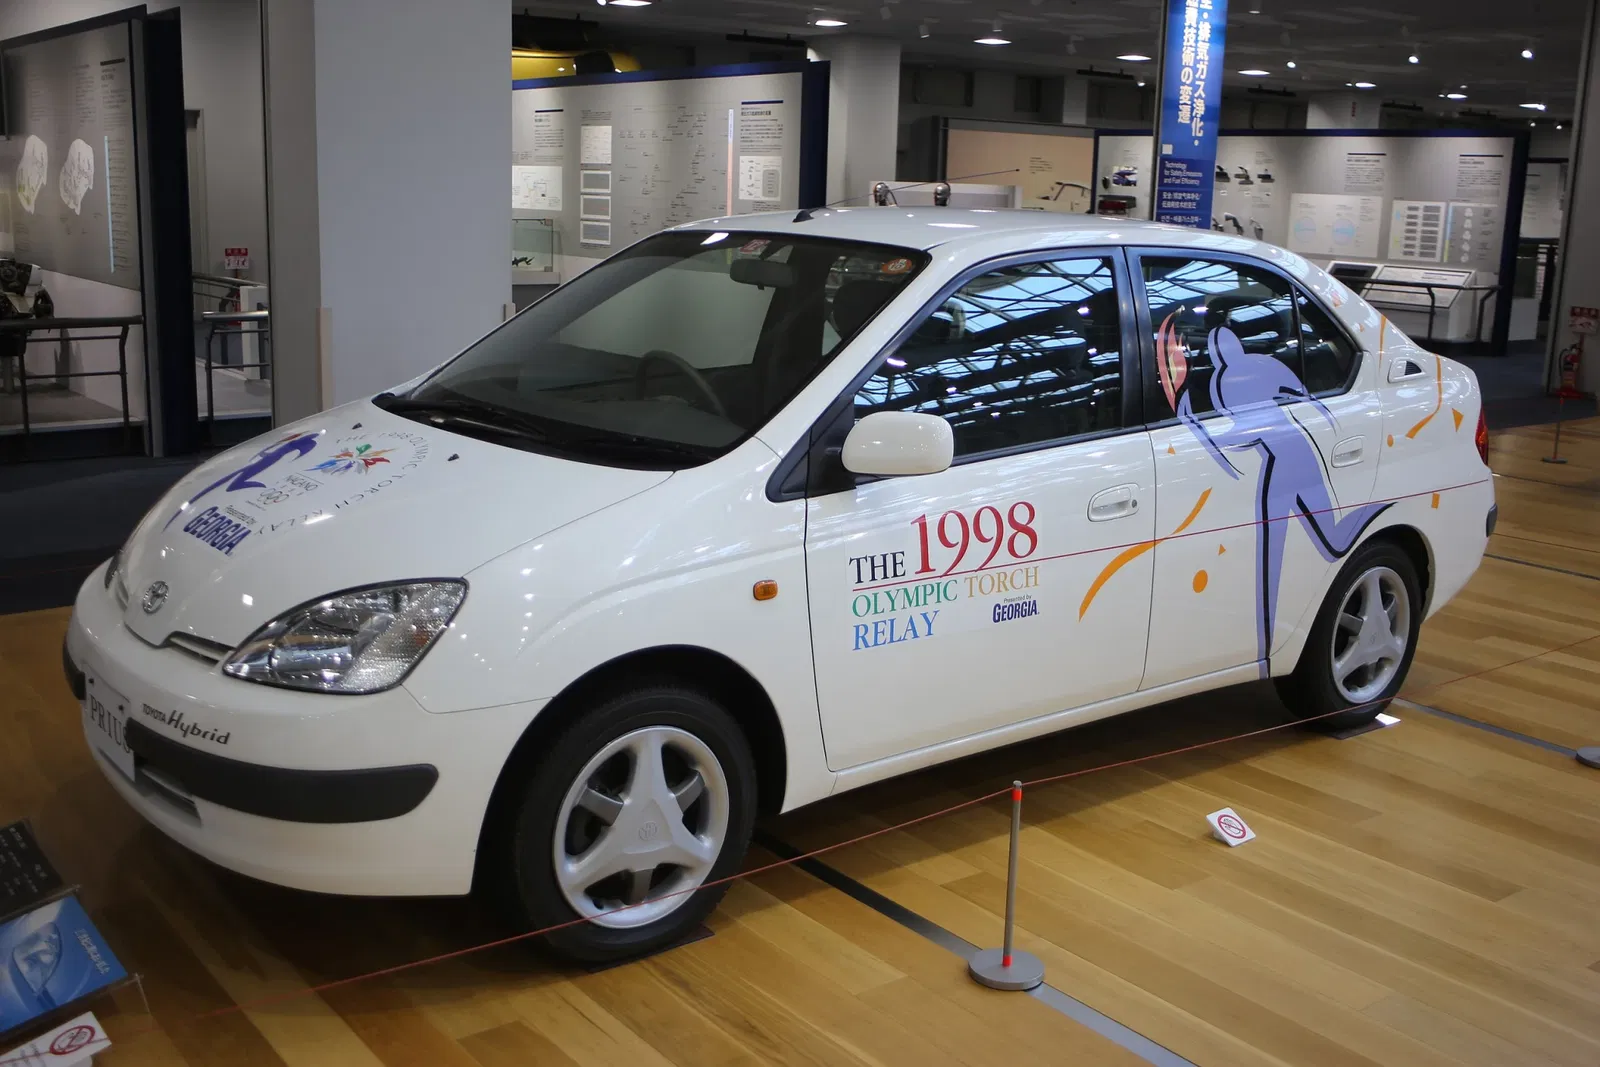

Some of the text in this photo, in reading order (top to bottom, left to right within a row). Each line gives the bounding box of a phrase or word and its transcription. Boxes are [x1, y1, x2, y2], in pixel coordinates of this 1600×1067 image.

[183, 506, 252, 555] GEORGIA
[849, 501, 1038, 584] THE 1998
[852, 565, 1040, 618] OLYMPIC TORCH
[992, 600, 1038, 623] GEORGIA
[1003, 594, 1032, 603] Presented by
[852, 610, 940, 651] RELAY
[142, 703, 231, 745] TOYOTA Hybrid
